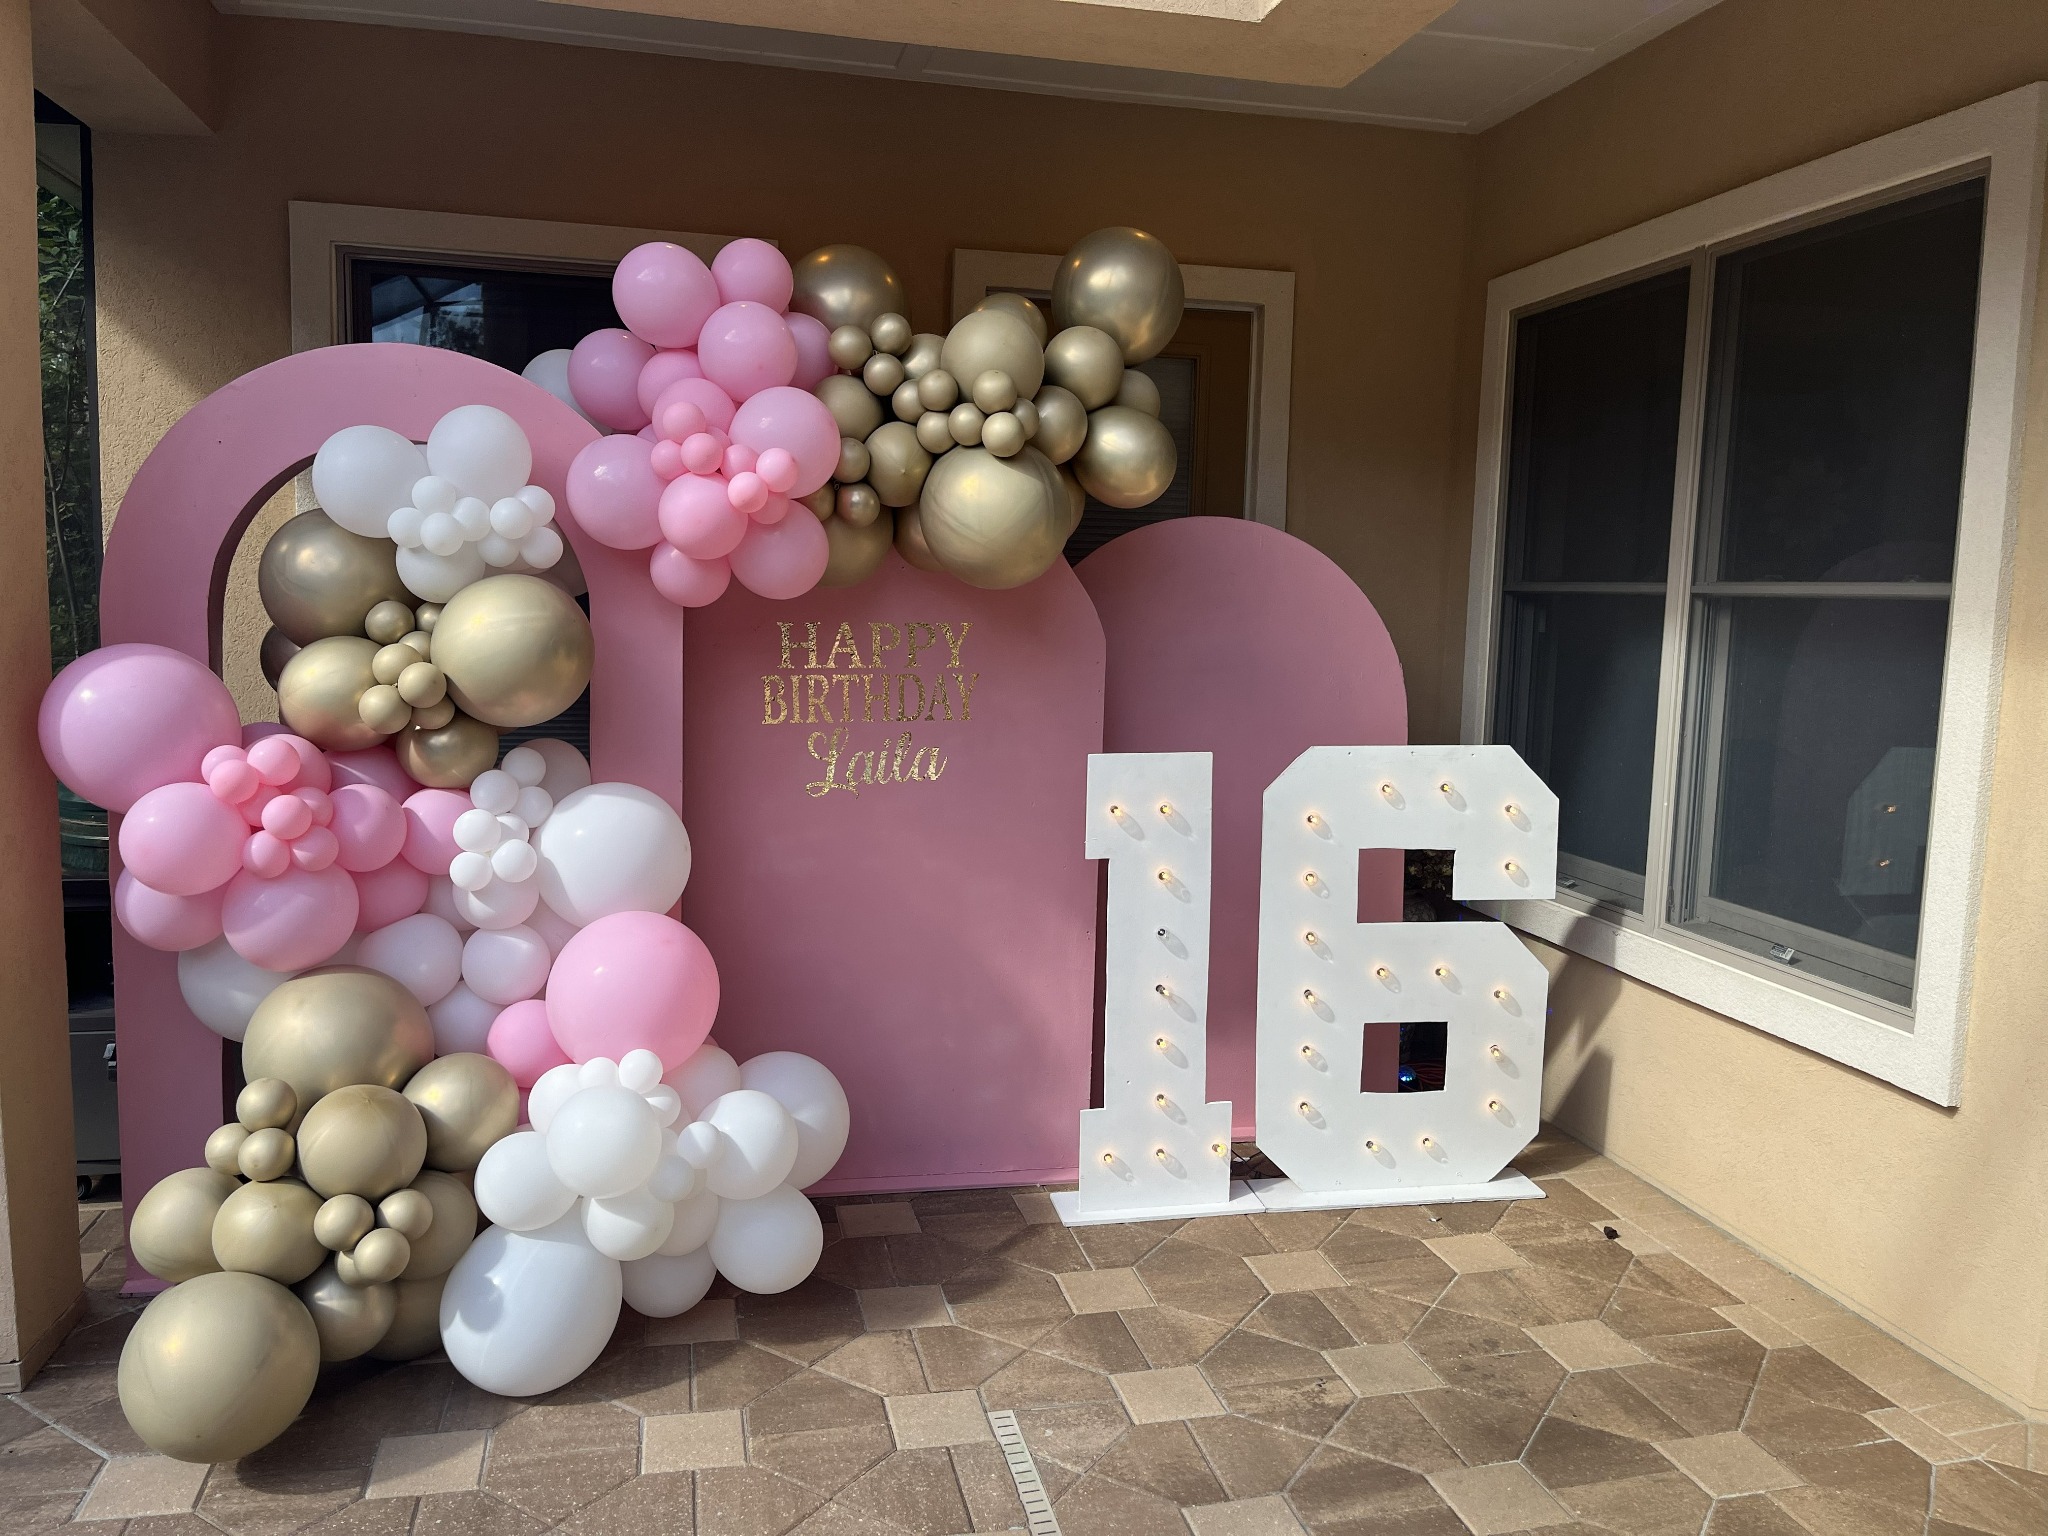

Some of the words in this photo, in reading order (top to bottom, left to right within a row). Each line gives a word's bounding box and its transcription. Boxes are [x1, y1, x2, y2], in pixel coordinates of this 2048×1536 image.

[777, 621, 974, 669] HAPPY
[761, 673, 980, 724] BIRTHDAY
[806, 727, 949, 799] Laila
[1080, 745, 1560, 1211] 16
